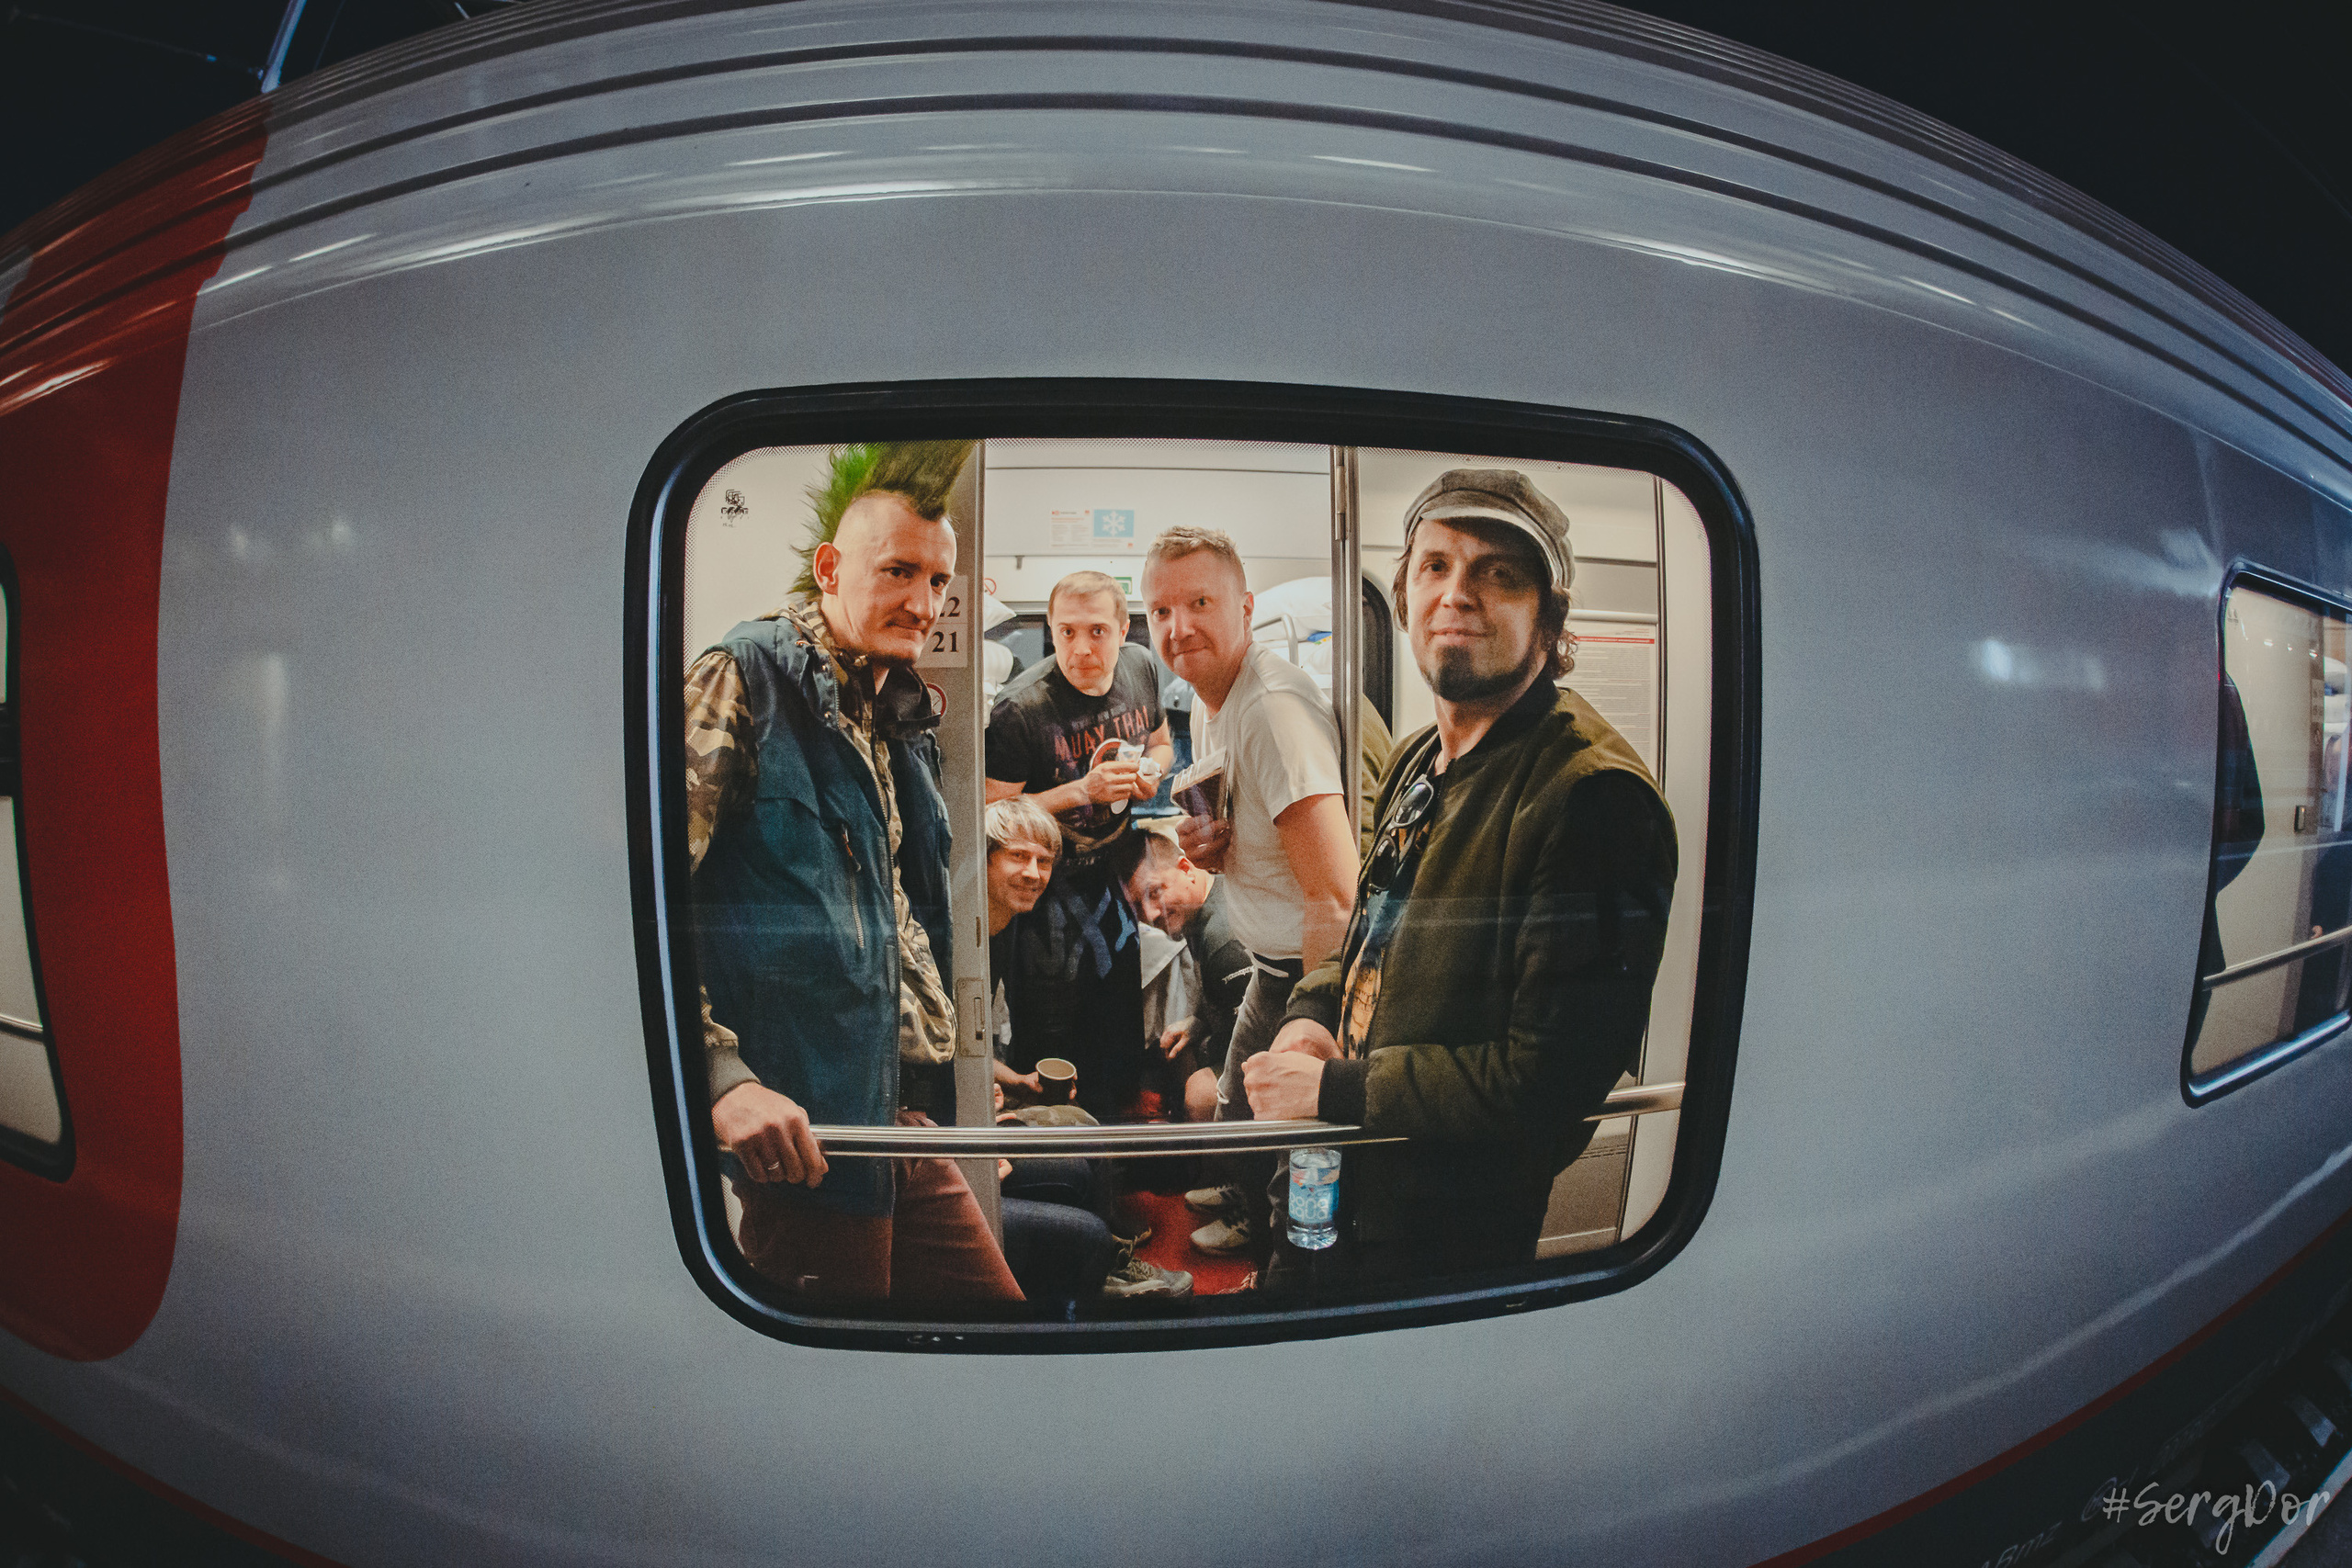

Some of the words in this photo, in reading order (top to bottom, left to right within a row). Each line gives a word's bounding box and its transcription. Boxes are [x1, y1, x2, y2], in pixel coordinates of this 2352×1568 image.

[939, 596, 961, 617] 2
[932, 630, 959, 653] 21
[1054, 724, 1104, 761] MUAY
[1113, 705, 1149, 739] THAI
